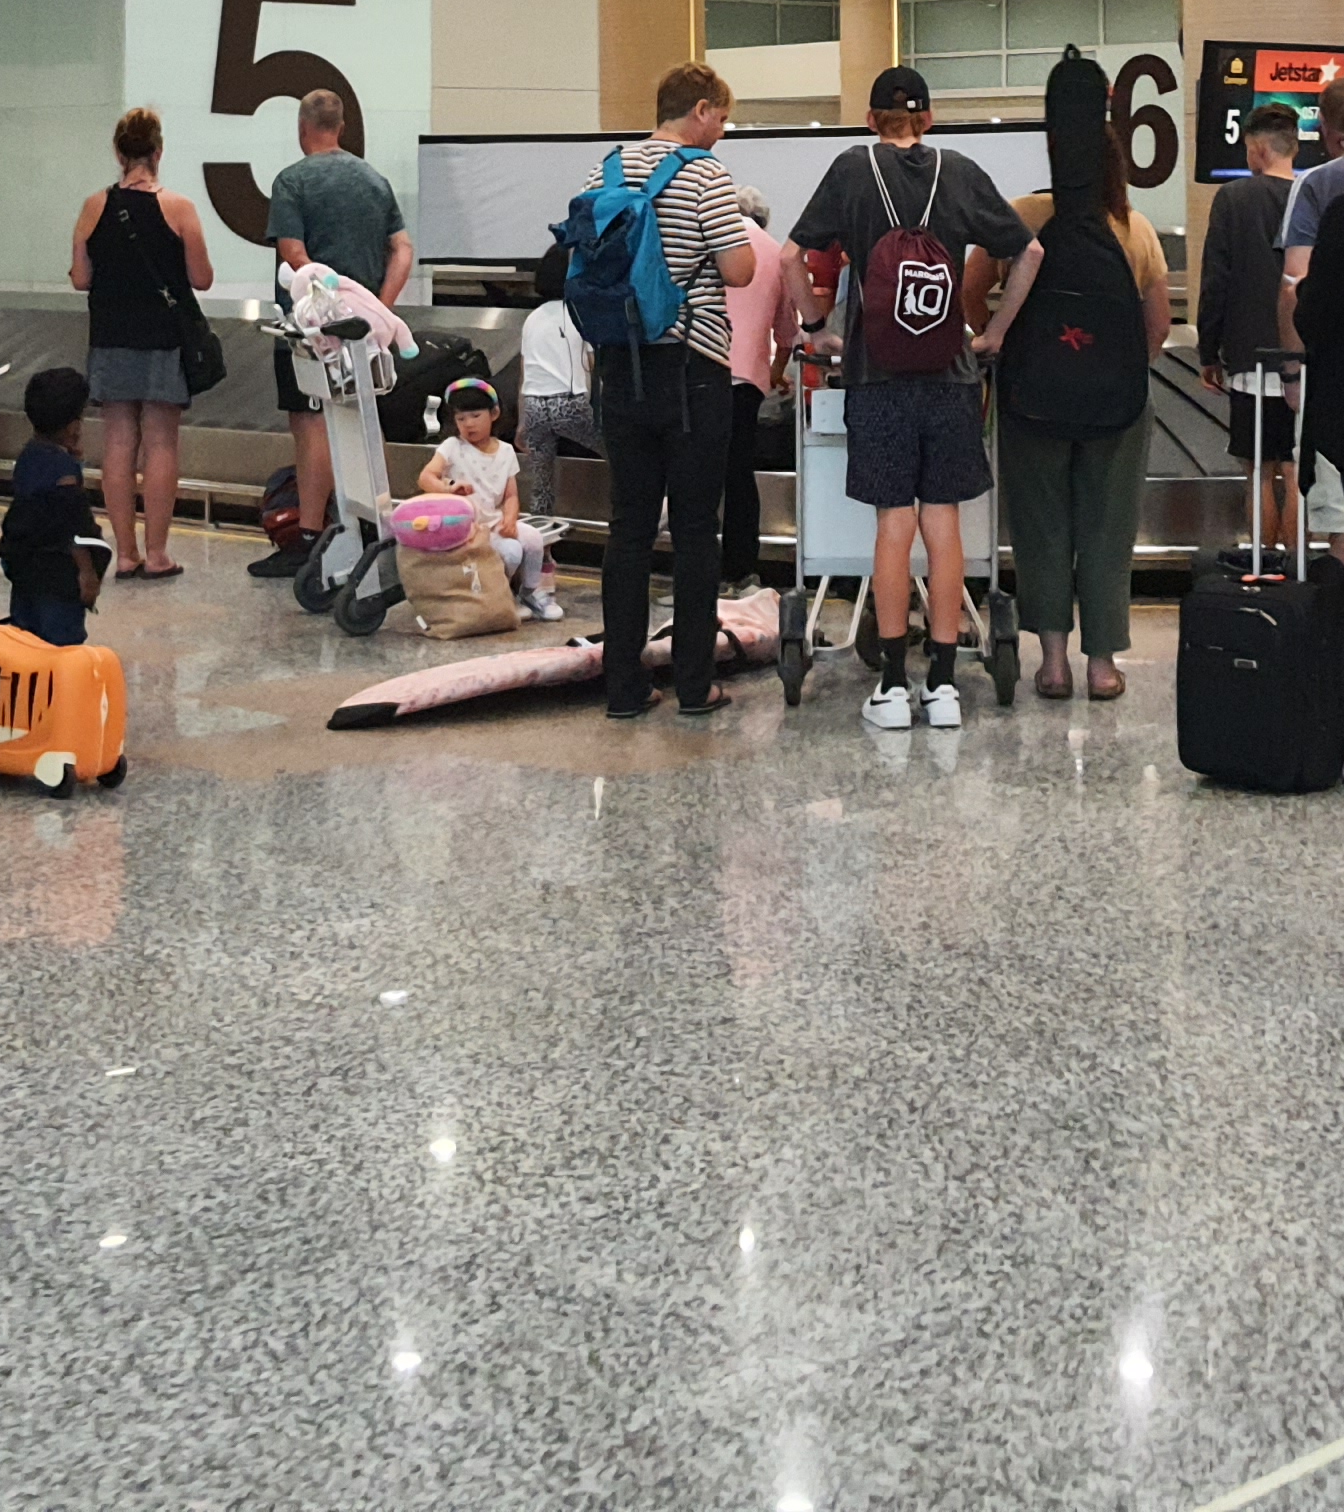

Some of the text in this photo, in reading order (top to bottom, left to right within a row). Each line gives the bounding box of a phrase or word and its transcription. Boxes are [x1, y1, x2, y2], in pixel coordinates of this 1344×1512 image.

[1270, 62, 1323, 83] Jetstar
[1111, 54, 1179, 188] 6
[1224, 109, 1241, 145] 5
